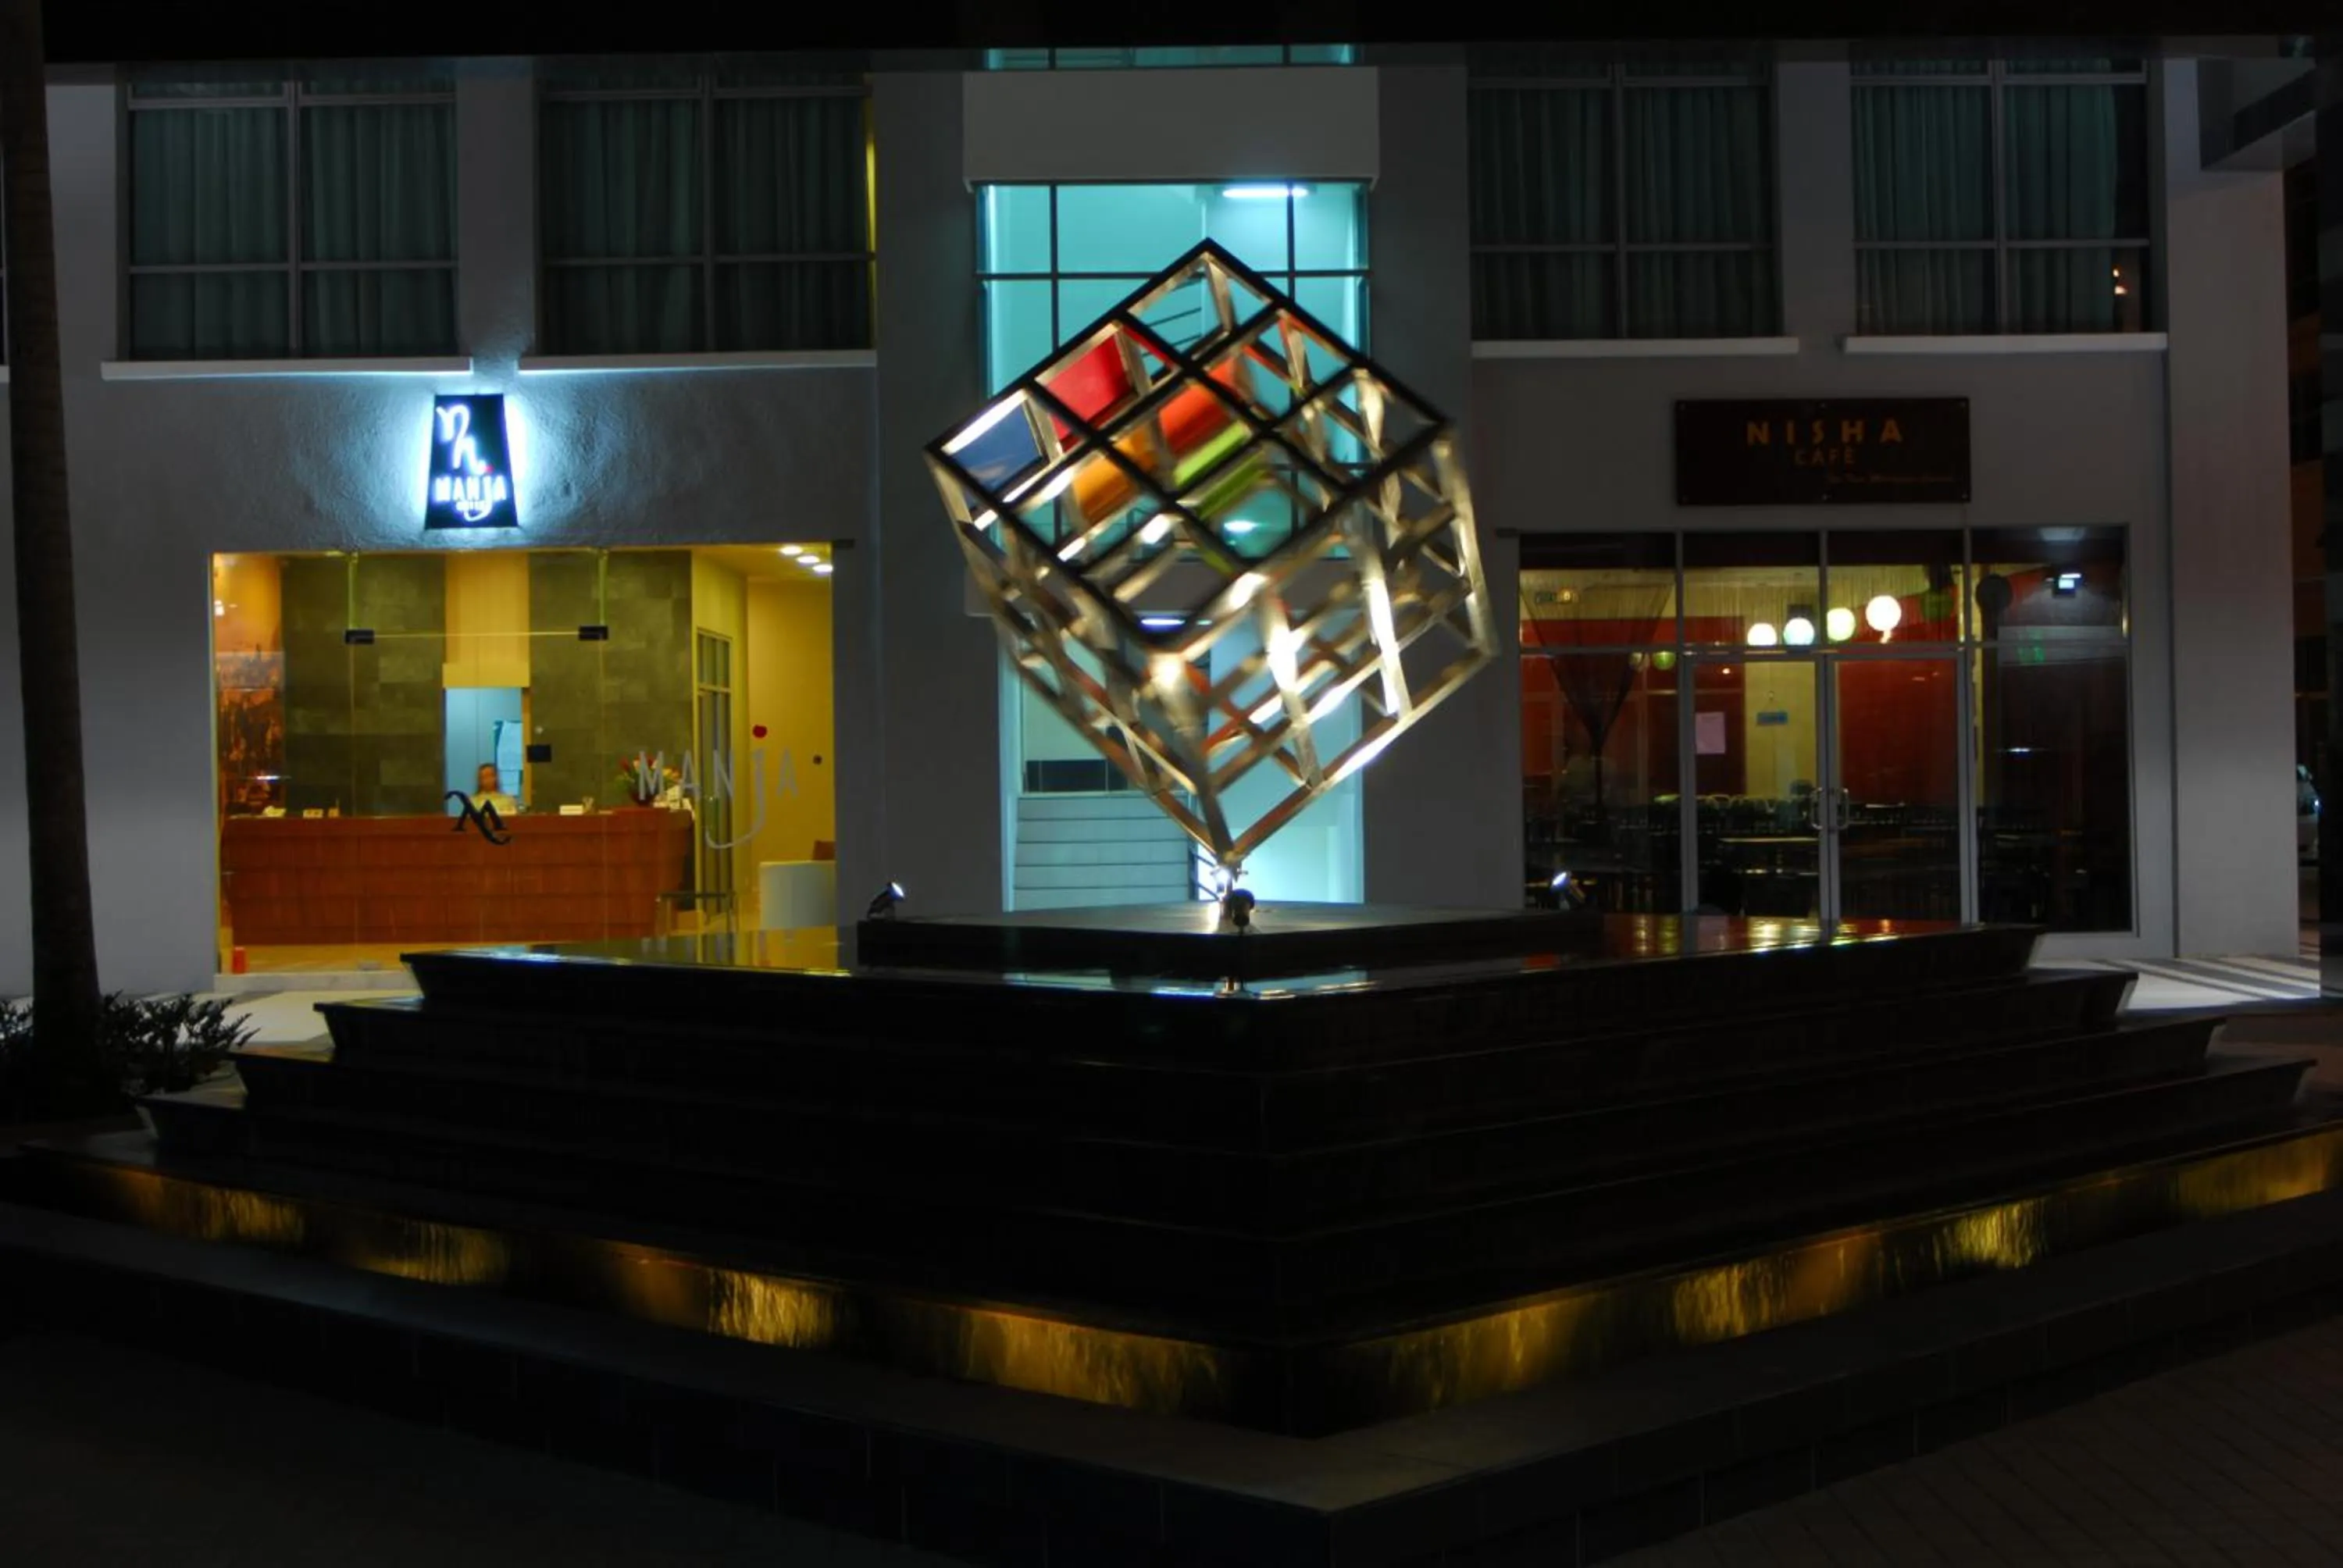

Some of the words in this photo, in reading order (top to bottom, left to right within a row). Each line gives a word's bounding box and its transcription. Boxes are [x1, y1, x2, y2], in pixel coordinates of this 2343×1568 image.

[1746, 418, 1904, 446] NISHA
[435, 475, 507, 522] MANJA
[639, 747, 799, 849] MANJA
